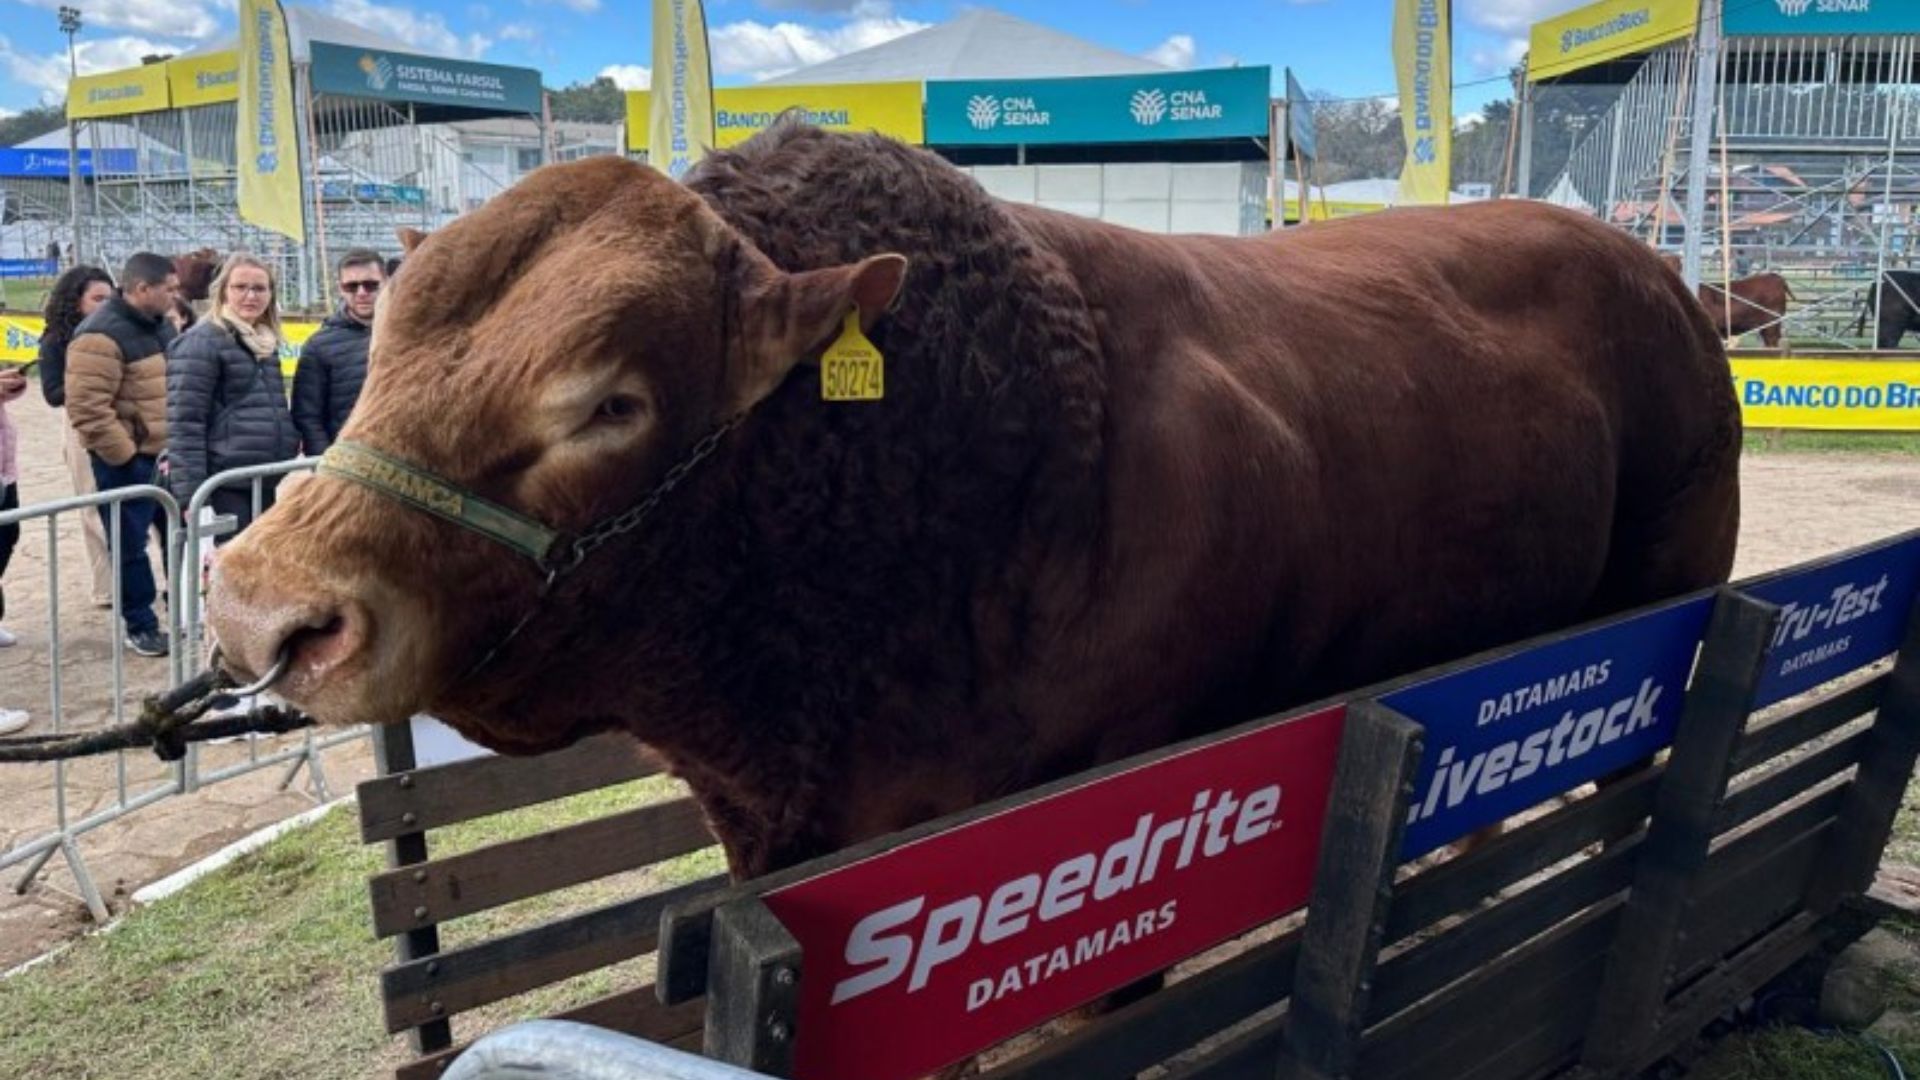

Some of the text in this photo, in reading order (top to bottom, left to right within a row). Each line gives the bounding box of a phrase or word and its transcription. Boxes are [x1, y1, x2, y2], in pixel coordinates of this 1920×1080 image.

[396, 64, 504, 90] SISTEMA FARSUL
[1002, 98, 1035, 112] CNA
[1169, 104, 1222, 121] SENAR
[1170, 90, 1205, 105] CNA
[1002, 111, 1050, 126] SENAR
[827, 359, 880, 397] 50274
[1743, 380, 1840, 407] BANCO
[1845, 386, 1882, 408] DO
[1780, 635, 1852, 676] DATAMARS
[1476, 659, 1613, 727] DATAMARS
[1406, 675, 1664, 825] ivestock
[830, 784, 1281, 1005] Speedrite
[966, 900, 1178, 1012] DATAMARS
